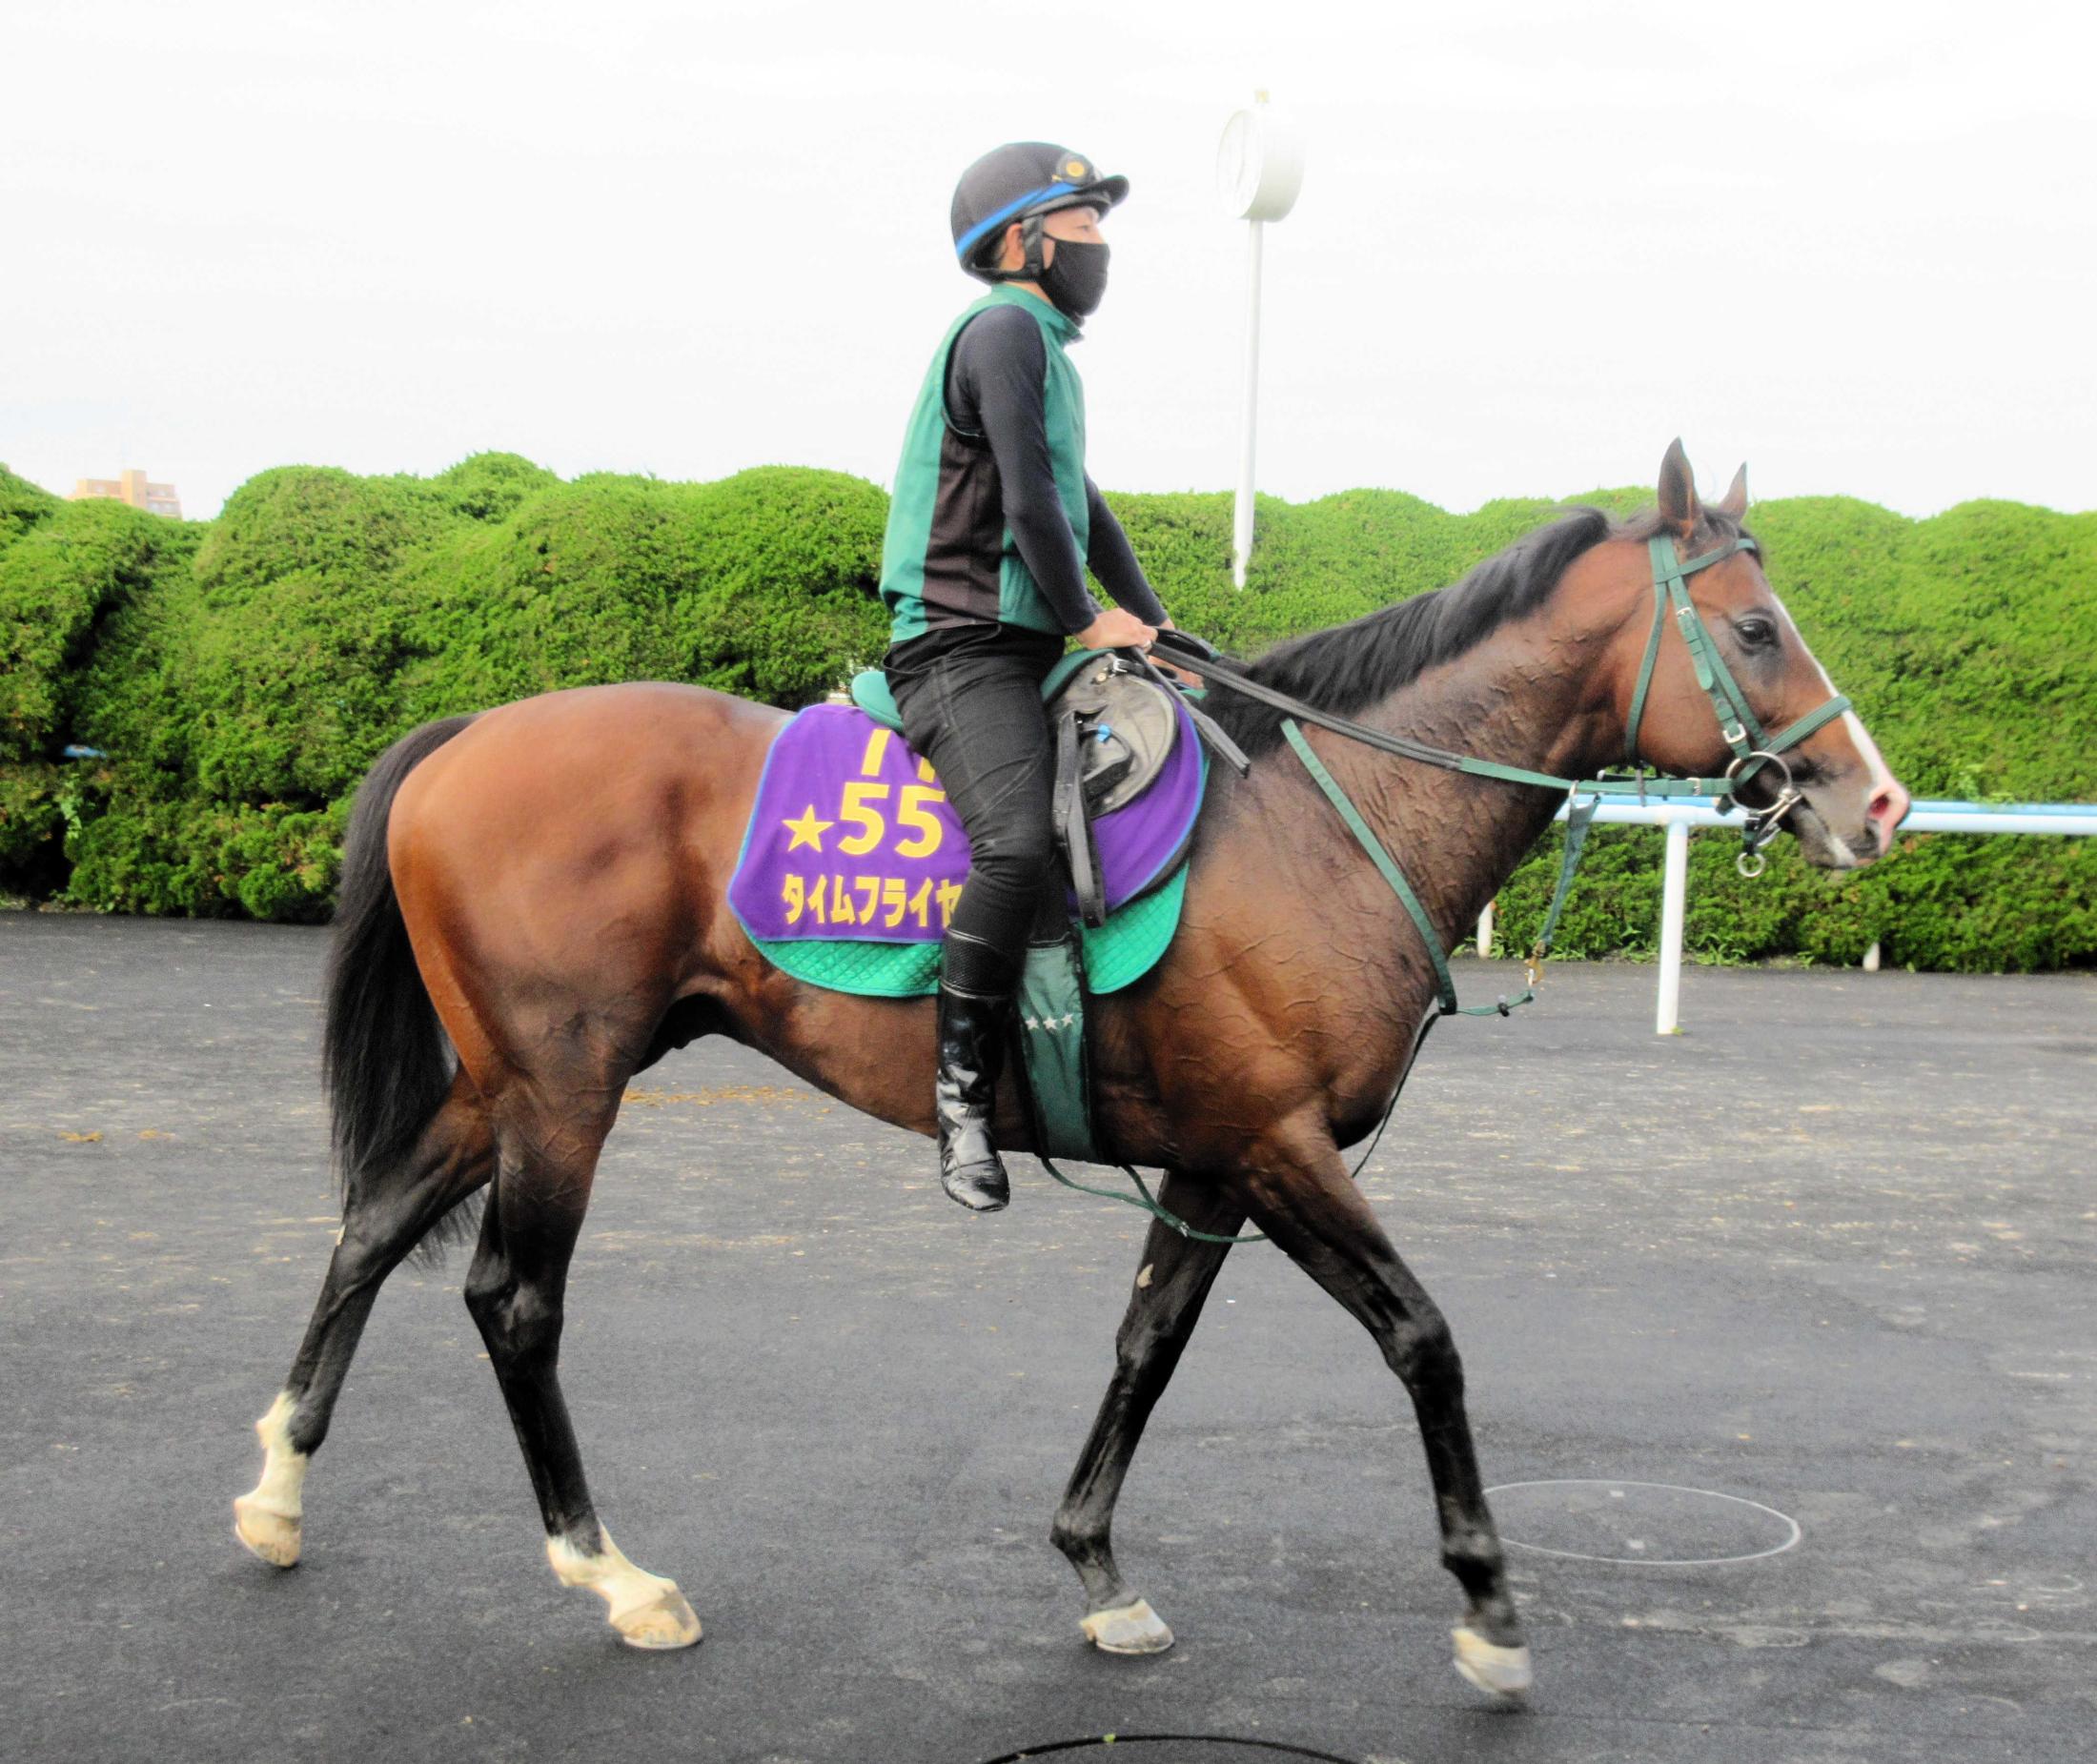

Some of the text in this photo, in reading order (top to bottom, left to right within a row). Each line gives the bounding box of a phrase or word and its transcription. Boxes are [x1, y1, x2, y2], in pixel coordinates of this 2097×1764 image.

[838, 781, 947, 859] 55
[782, 873, 964, 929] タイムフライヤ
